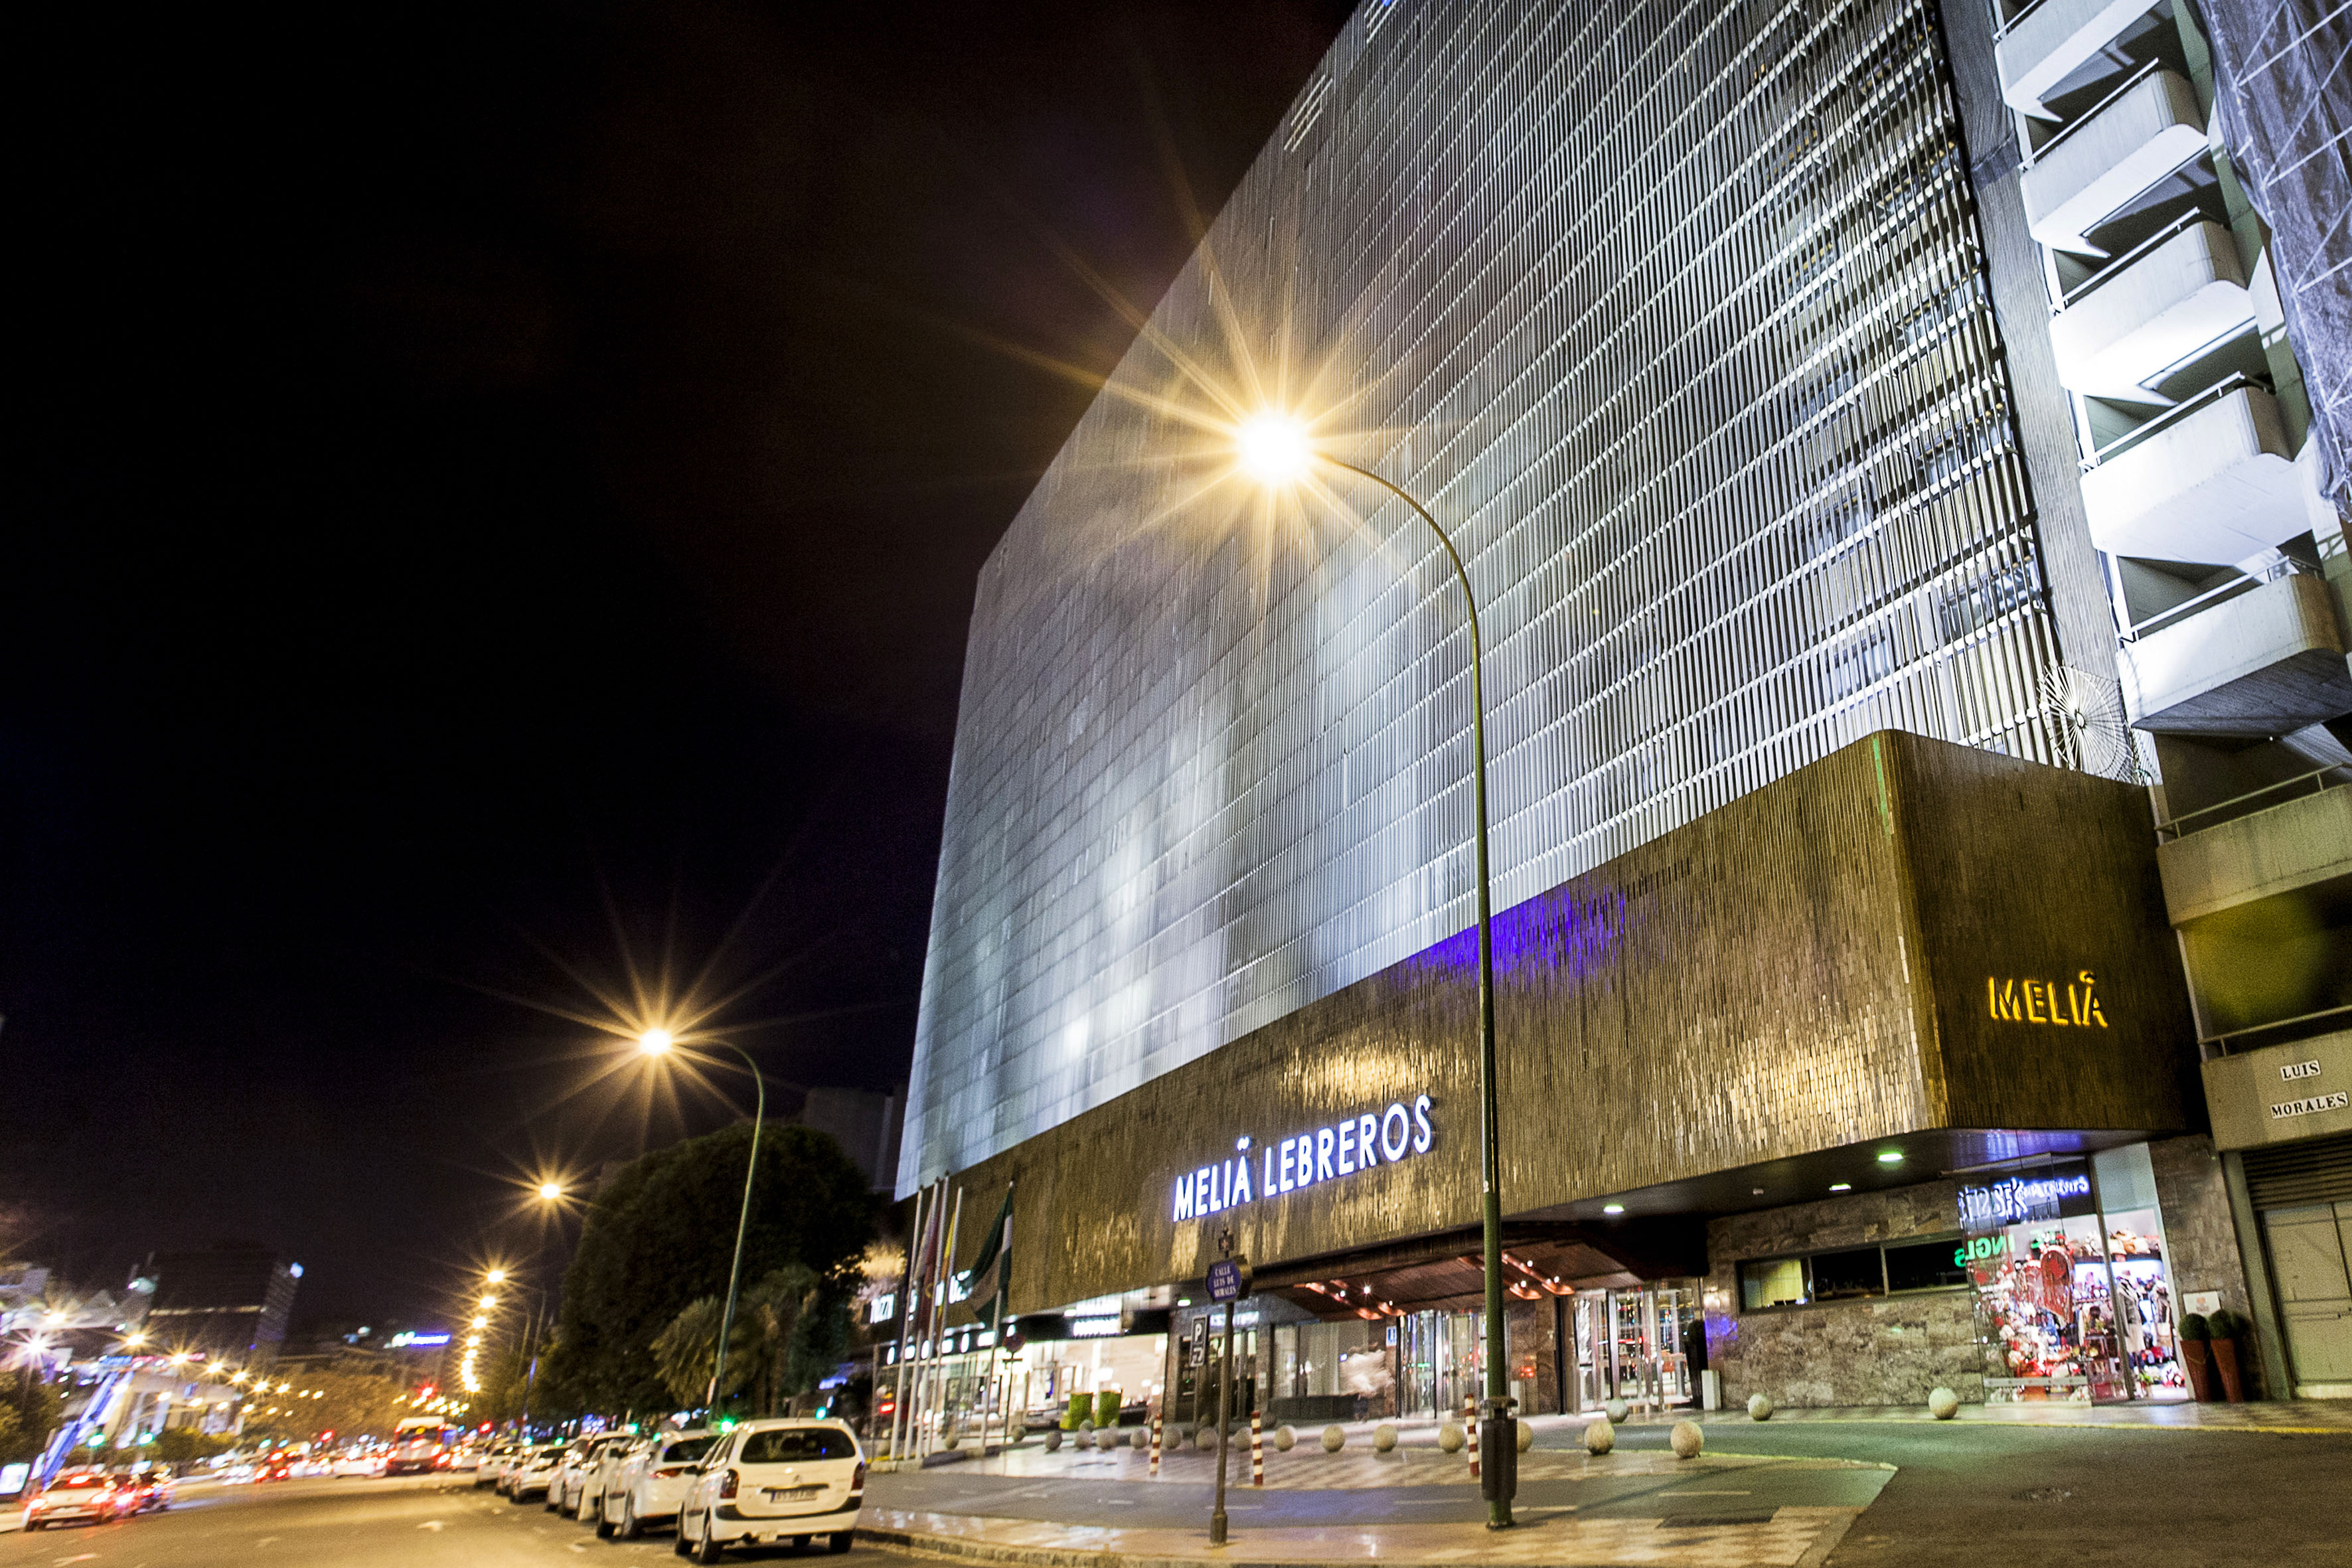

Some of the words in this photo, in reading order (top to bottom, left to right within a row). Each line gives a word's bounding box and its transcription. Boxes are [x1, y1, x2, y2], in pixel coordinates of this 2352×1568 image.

[2282, 1062, 2319, 1079] LUIS
[2271, 1093, 2347, 1117] MORALES
[1264, 1094, 1433, 1197] LEBREROS
[1214, 1265, 1231, 1277] CALLE
[1214, 1277, 1225, 1288] LUIS
[1227, 1275, 1234, 1285] DE
[1195, 1323, 1202, 1342] P
